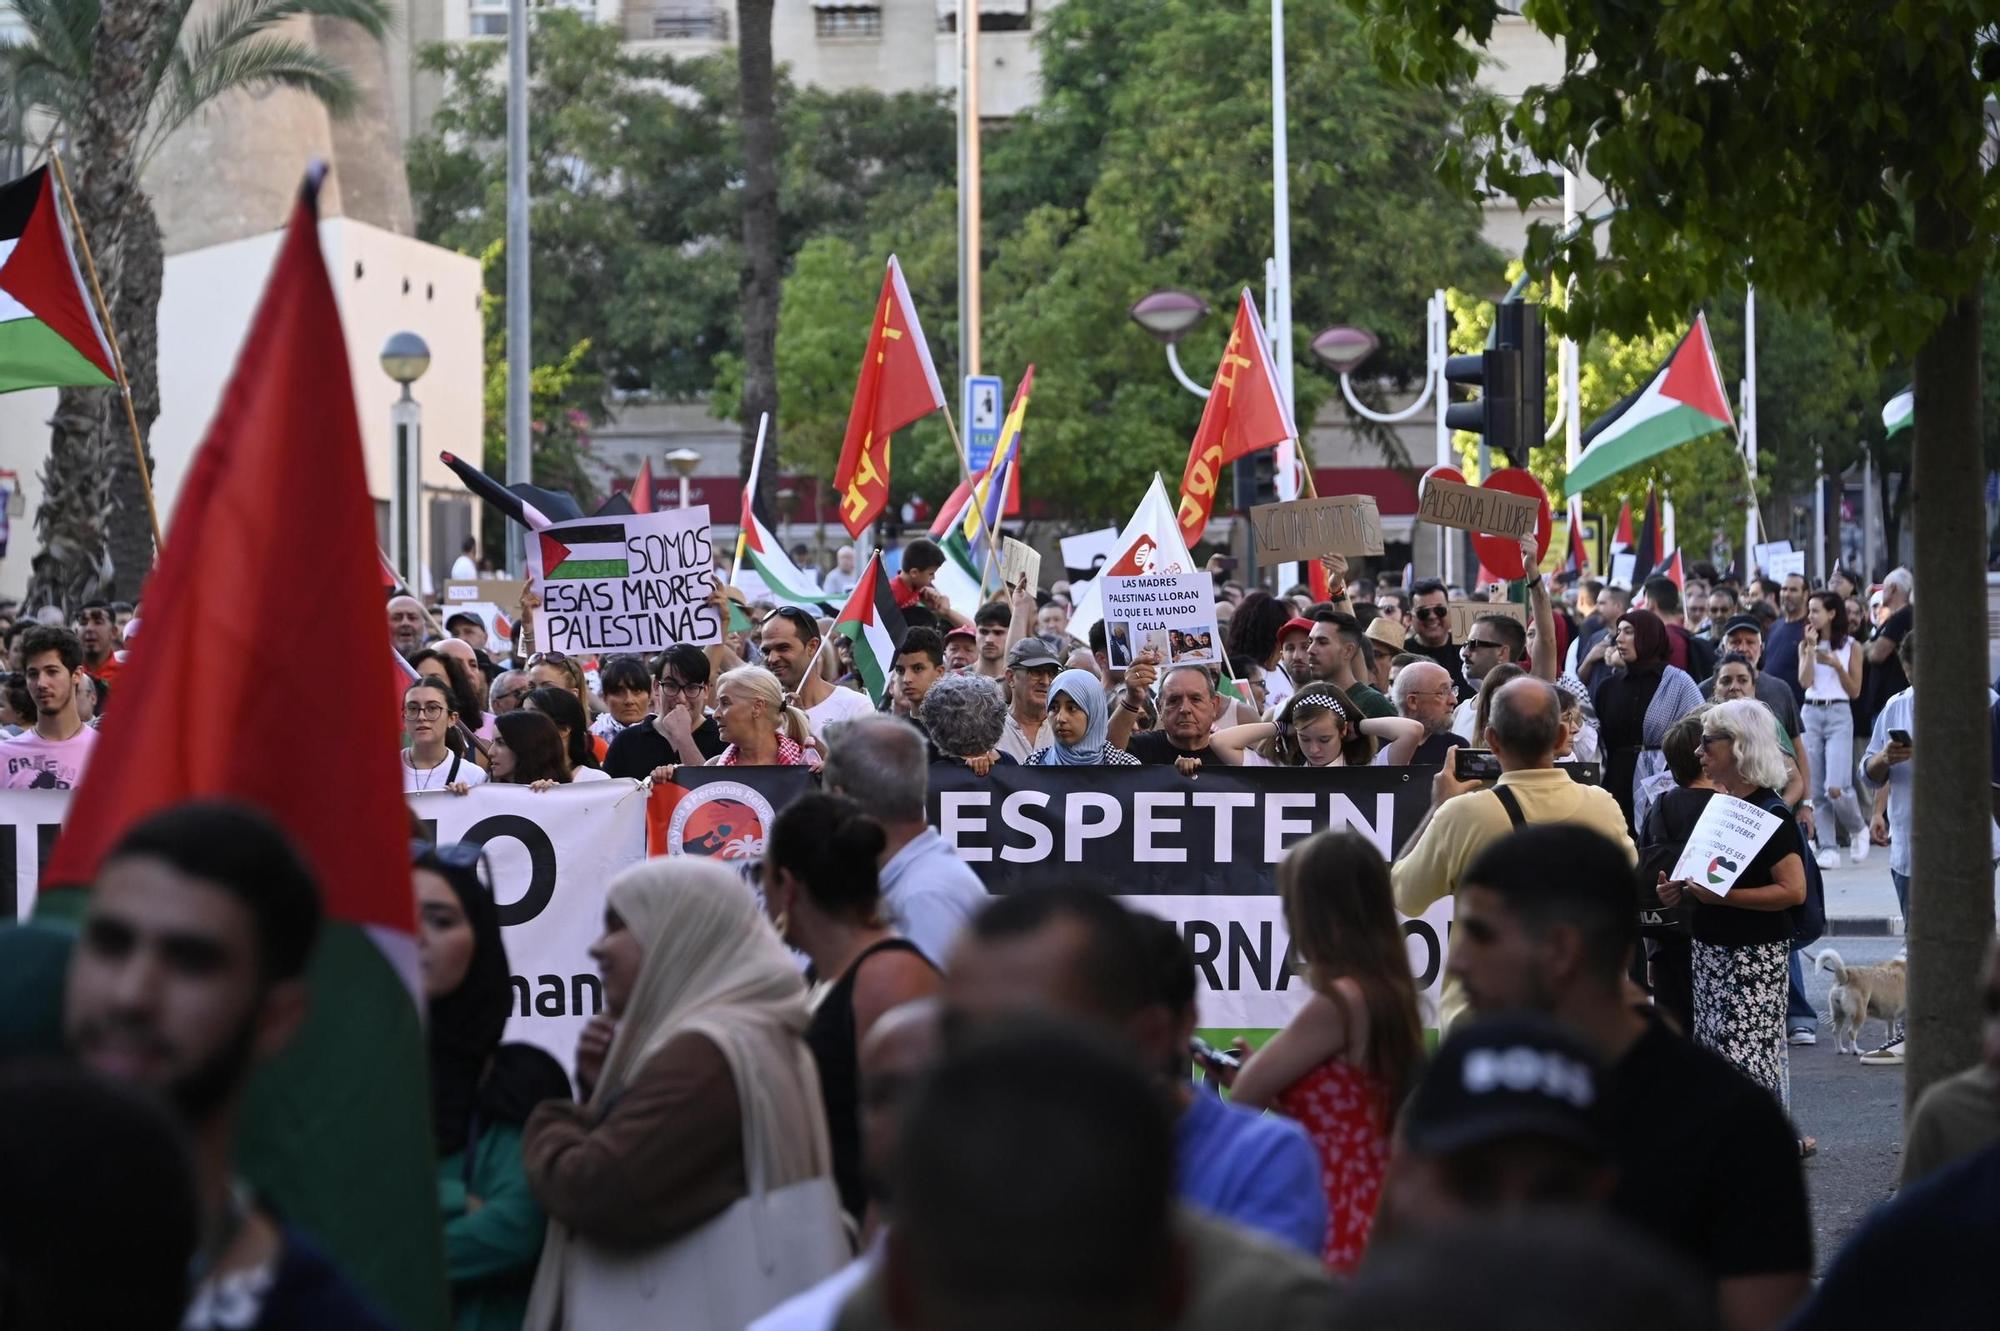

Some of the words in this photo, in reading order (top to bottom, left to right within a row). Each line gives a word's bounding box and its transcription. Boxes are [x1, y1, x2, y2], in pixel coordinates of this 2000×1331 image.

[1420, 481, 1484, 527] PALESTINA
[628, 525, 712, 574] SOMOS
[543, 582, 613, 612] ESAS
[622, 569, 716, 612] MADRES
[1122, 579, 1136, 588] LAS
[1138, 577, 1177, 588] MADRES
[1109, 593, 1156, 602] PALESTINAS
[1158, 590, 1199, 601] LLORAN
[1113, 608, 1123, 617] LO
[1124, 608, 1141, 618] QUE
[1143, 608, 1153, 616] EL
[1155, 605, 1196, 616] MUNDO
[548, 603, 718, 651] PALESTINAS
[1136, 621, 1167, 631] CALLA
[691, 785, 743, 803] Personas
[1736, 801, 1747, 810] NO
[1747, 804, 1766, 819] TIENE
[940, 791, 1395, 863] ESPETEN
[1726, 822, 1735, 830] UN
[1735, 825, 1756, 840] DEBER
[1754, 822, 1762, 831] EL
[1725, 847, 1734, 856] ES
[1733, 851, 1746, 862] SER
[1640, 911, 1663, 924] ILA
